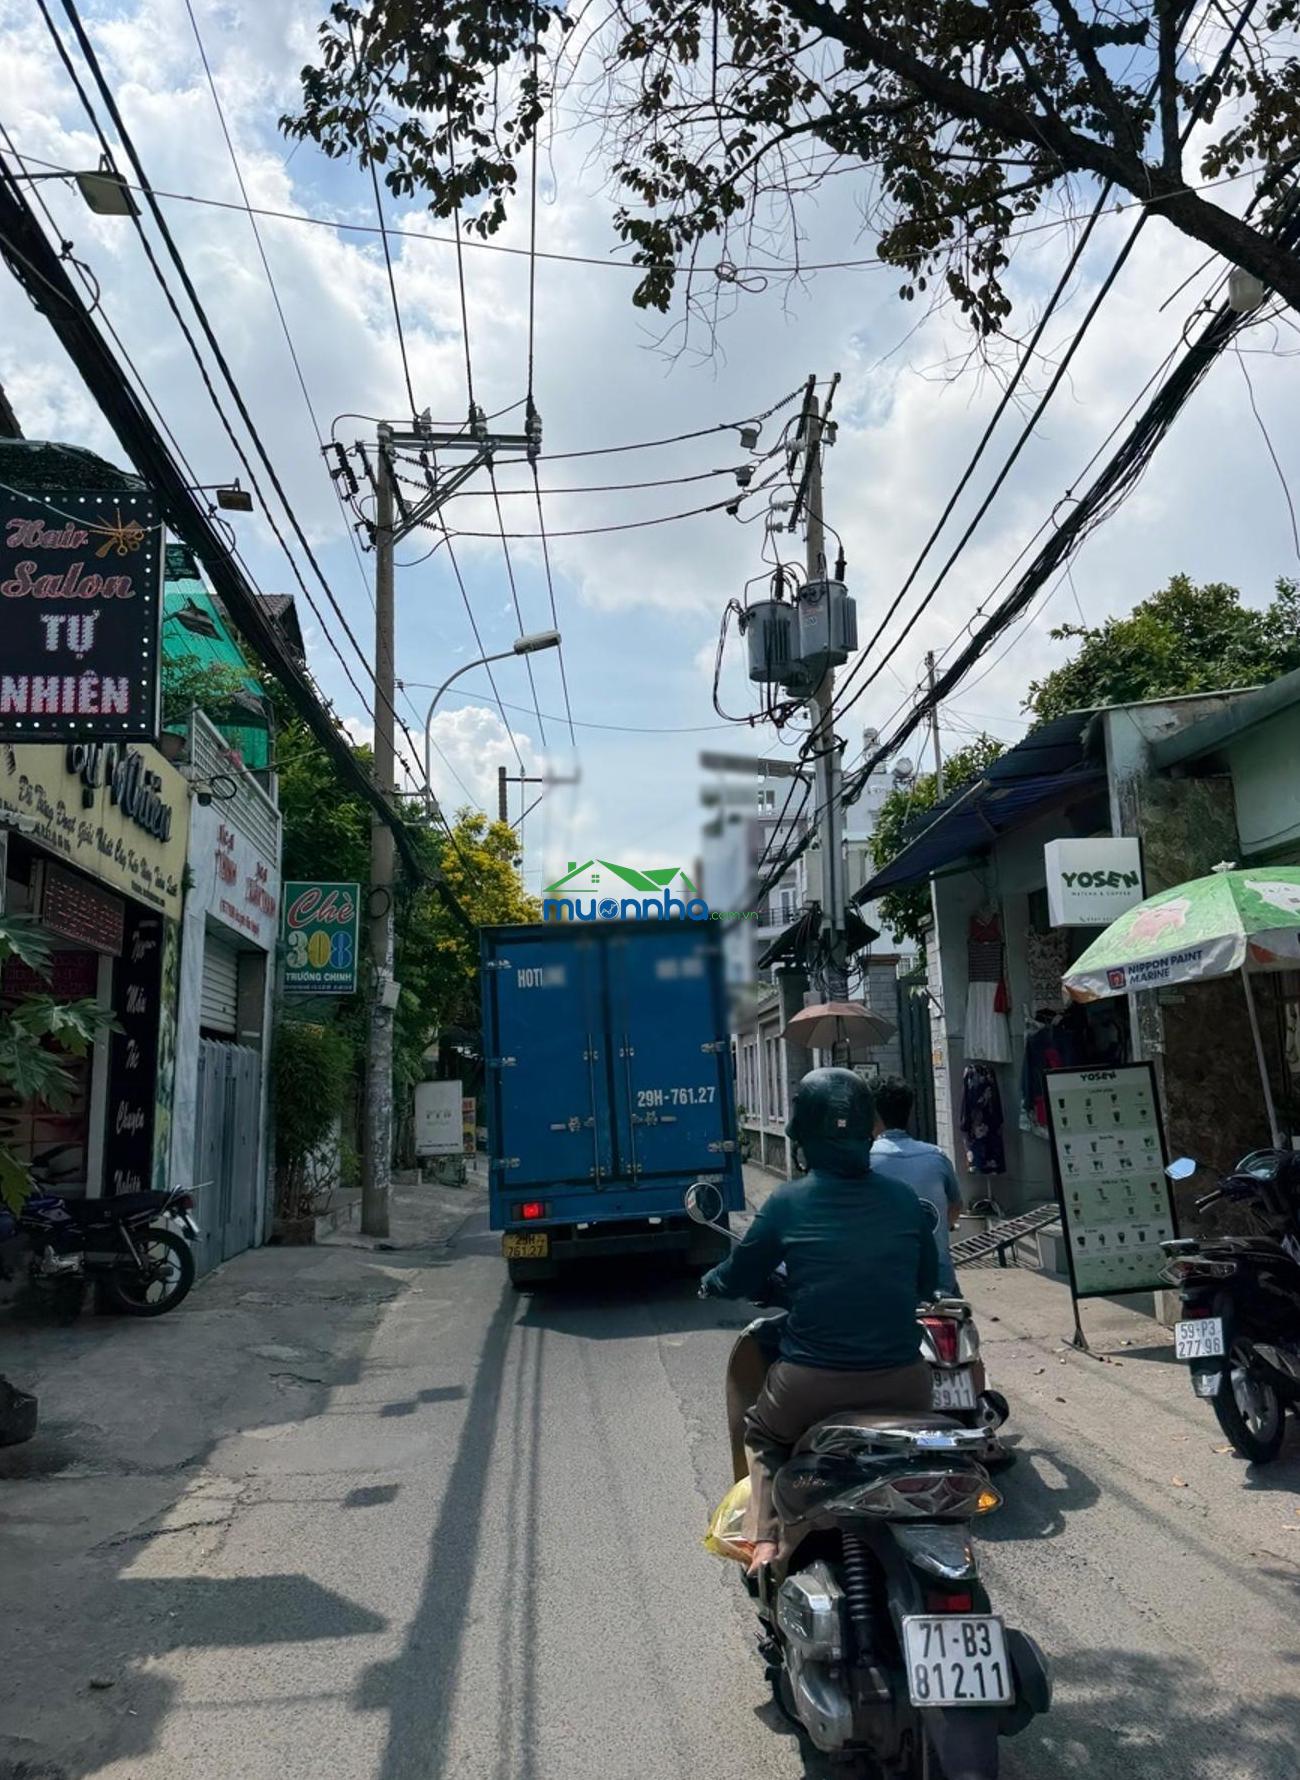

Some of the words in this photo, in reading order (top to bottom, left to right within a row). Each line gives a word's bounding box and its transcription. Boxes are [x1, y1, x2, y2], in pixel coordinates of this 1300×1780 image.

[6, 518, 89, 549] Hair
[0, 560, 136, 598] Salon
[40, 609, 100, 660] TỰ
[0, 669, 130, 714] NHIÊN
[1061, 870, 1140, 888] YOSEN
[287, 888, 355, 929] Chè
[286, 930, 353, 969] 308
[1128, 958, 1169, 975] NIPPON
[1170, 951, 1203, 967] PAINT
[323, 972, 352, 981] CHINH
[1129, 967, 1170, 985] MARINE
[1080, 1071, 1117, 1081] YOSEN
[637, 1086, 715, 1107] 29H-761.27
[933, 1371, 964, 1388] 9-V1
[920, 1622, 991, 1658] 71-B3
[915, 1661, 1004, 1699] 812.11
